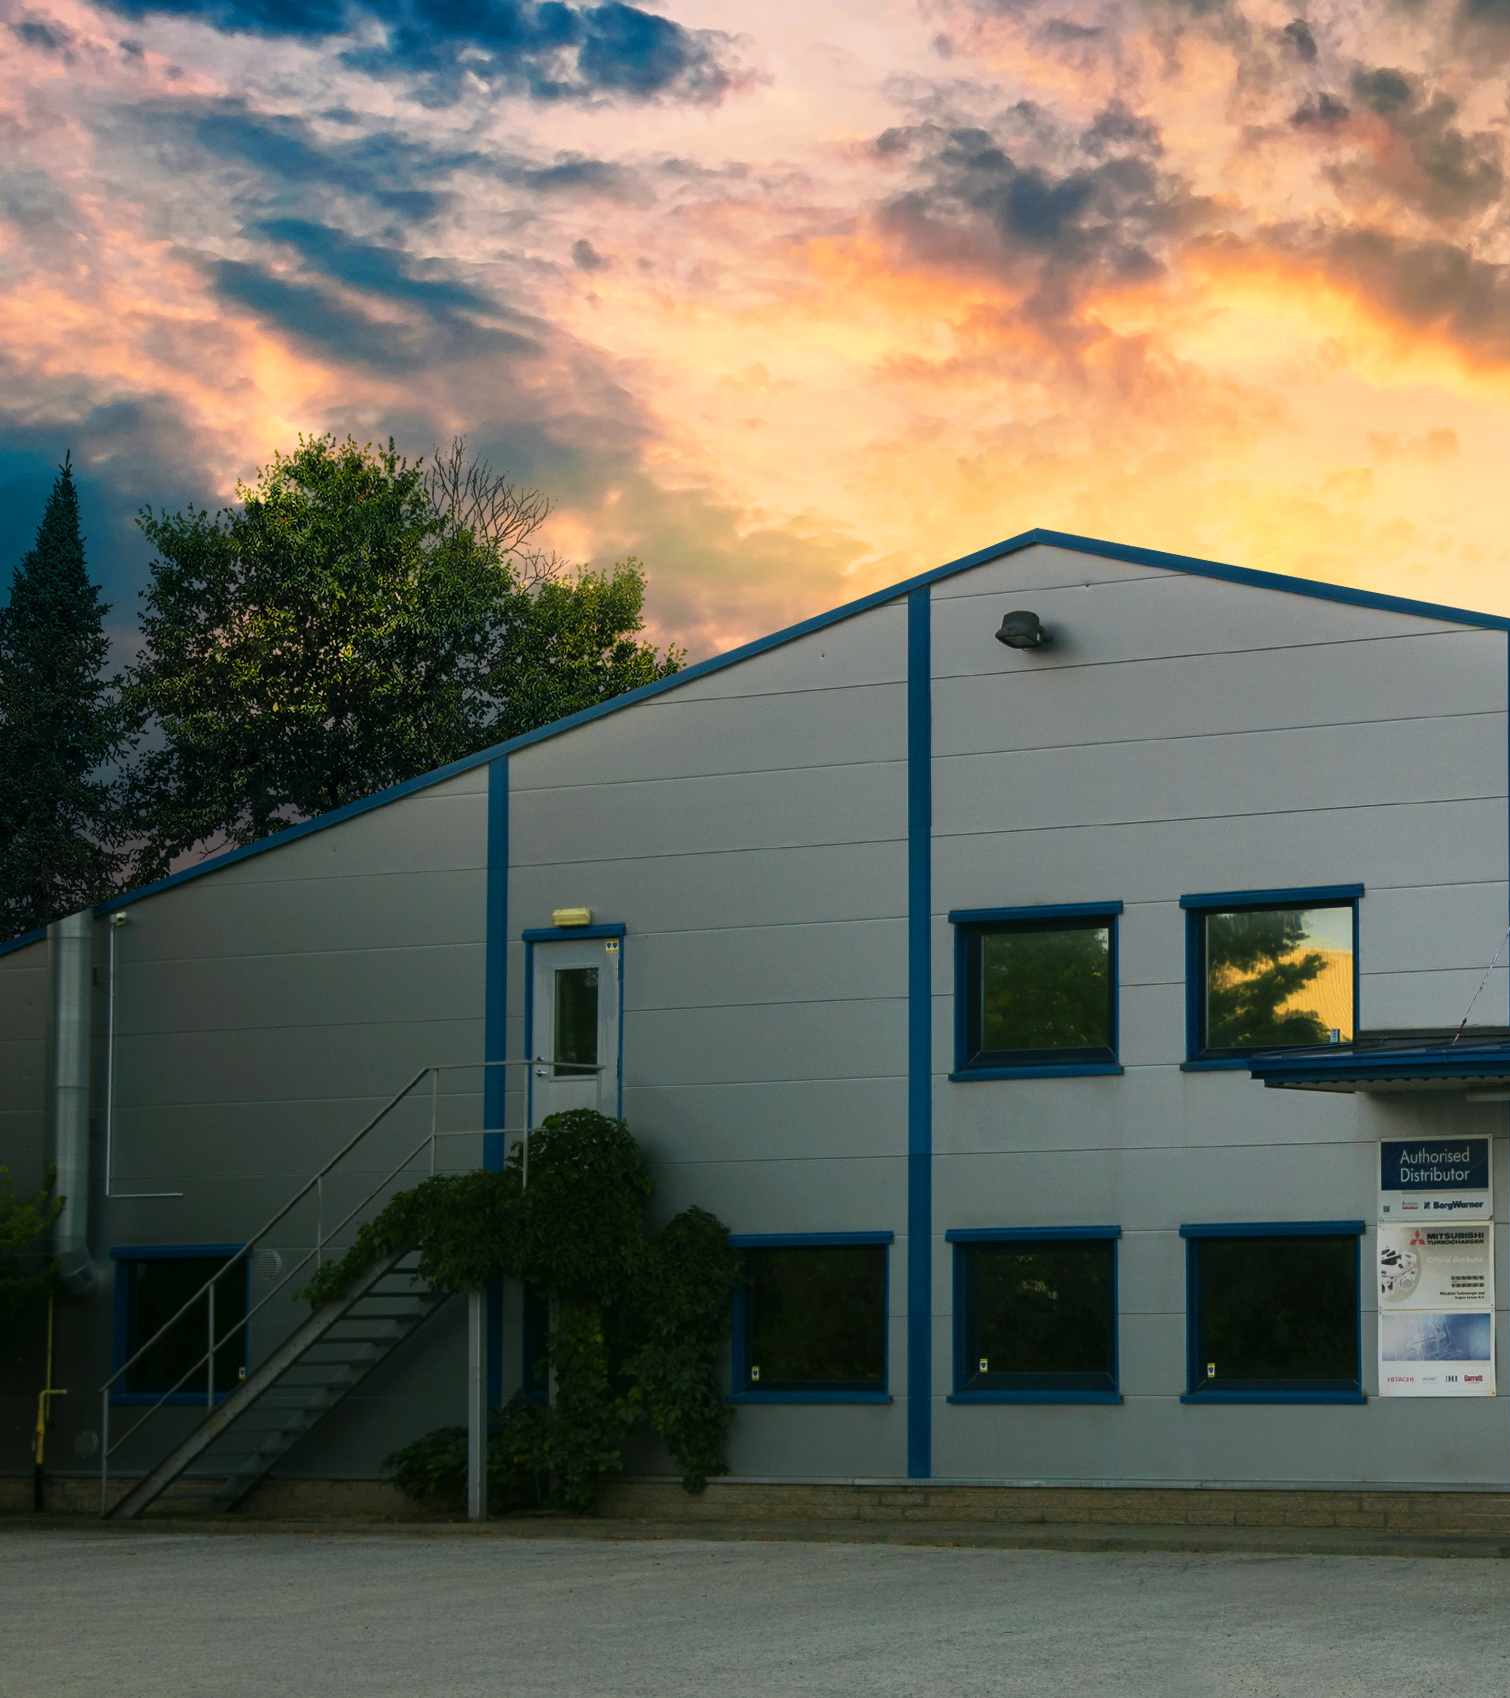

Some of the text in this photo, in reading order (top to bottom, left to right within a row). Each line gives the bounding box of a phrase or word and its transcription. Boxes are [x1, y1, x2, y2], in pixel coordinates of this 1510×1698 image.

[1400, 1146, 1470, 1164] Authorised
[1400, 1166, 1470, 1182] Distributor
[1433, 1201, 1484, 1210] BorgWarner
[1427, 1232, 1485, 1240] MITSUBISHI
[1445, 1375, 1458, 1383] IHI
